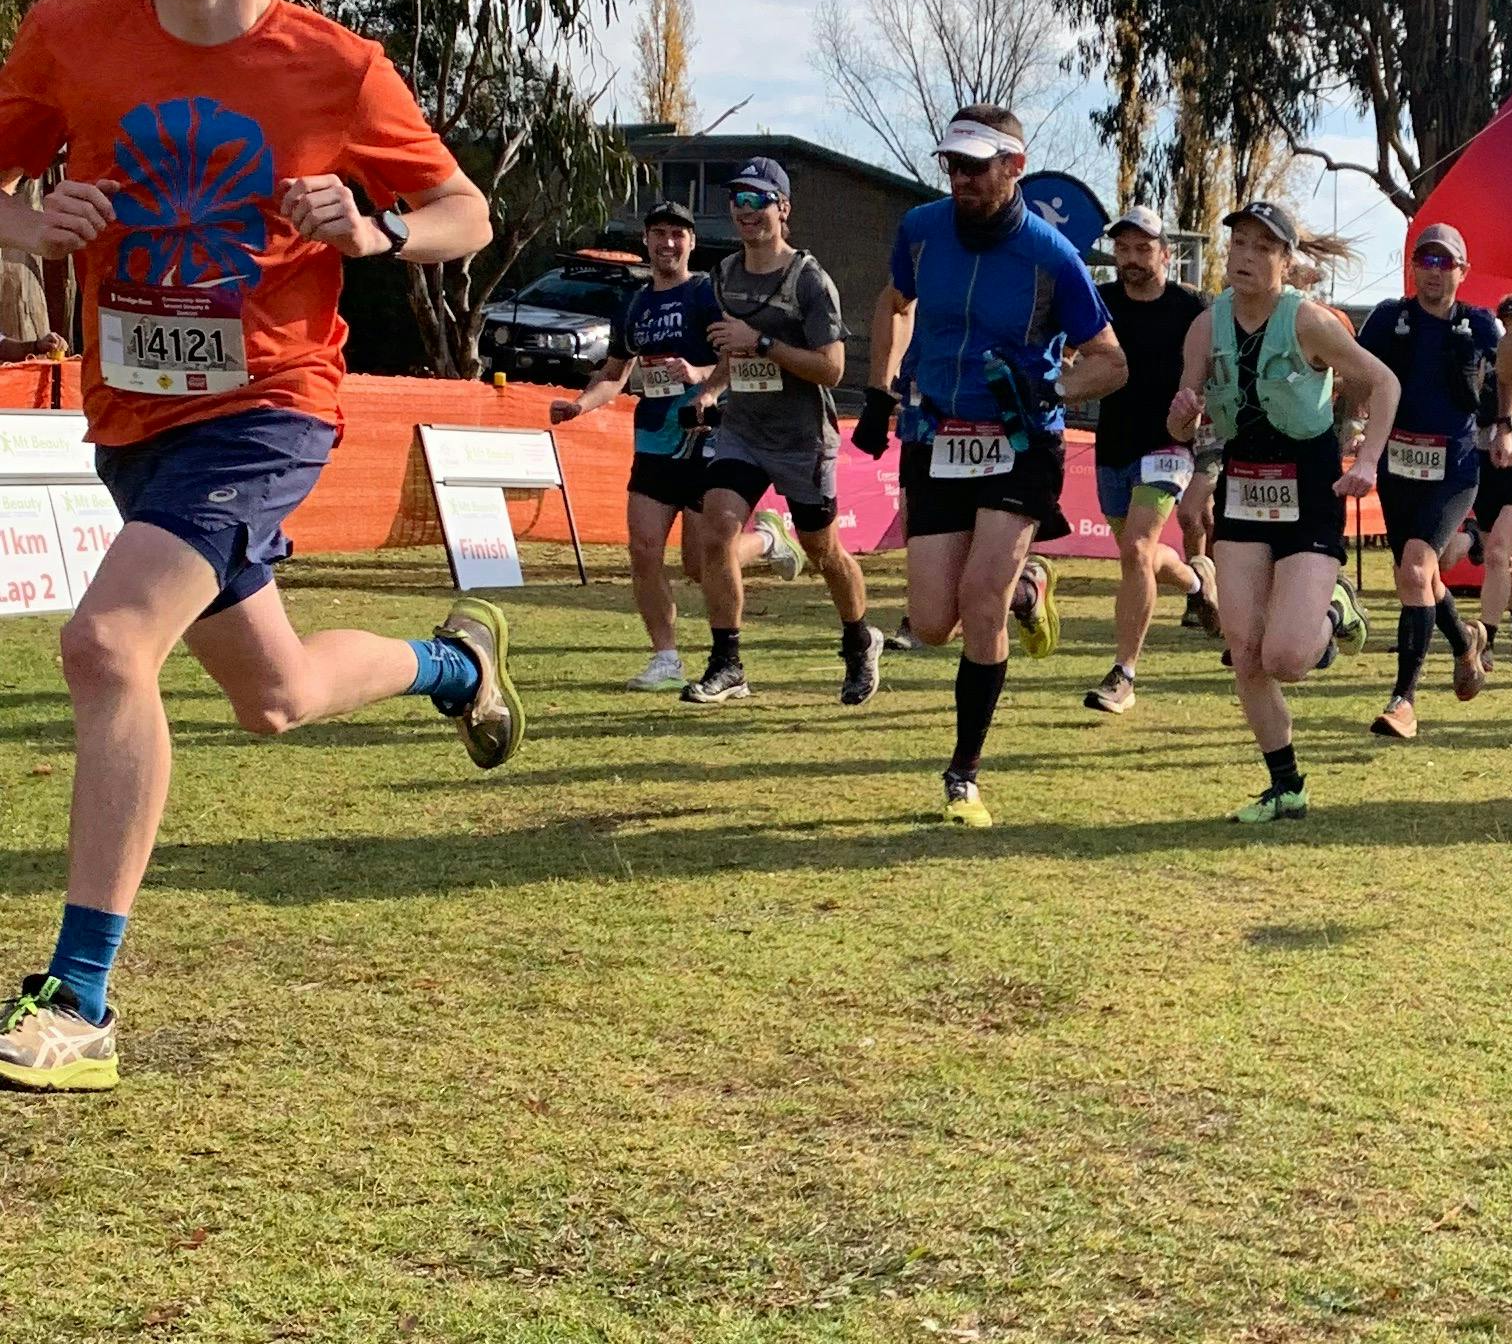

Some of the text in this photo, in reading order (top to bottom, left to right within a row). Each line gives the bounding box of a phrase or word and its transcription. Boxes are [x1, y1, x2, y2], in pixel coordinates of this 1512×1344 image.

[133, 324, 224, 363] 14121
[737, 362, 777, 378] 18020
[946, 438, 1002, 465] 1104
[1400, 448, 1440, 466] 18018
[1242, 485, 1291, 505] 14108
[73, 524, 117, 553] 21k
[459, 536, 509, 560] Finish
[40, 573, 56, 599] 2
